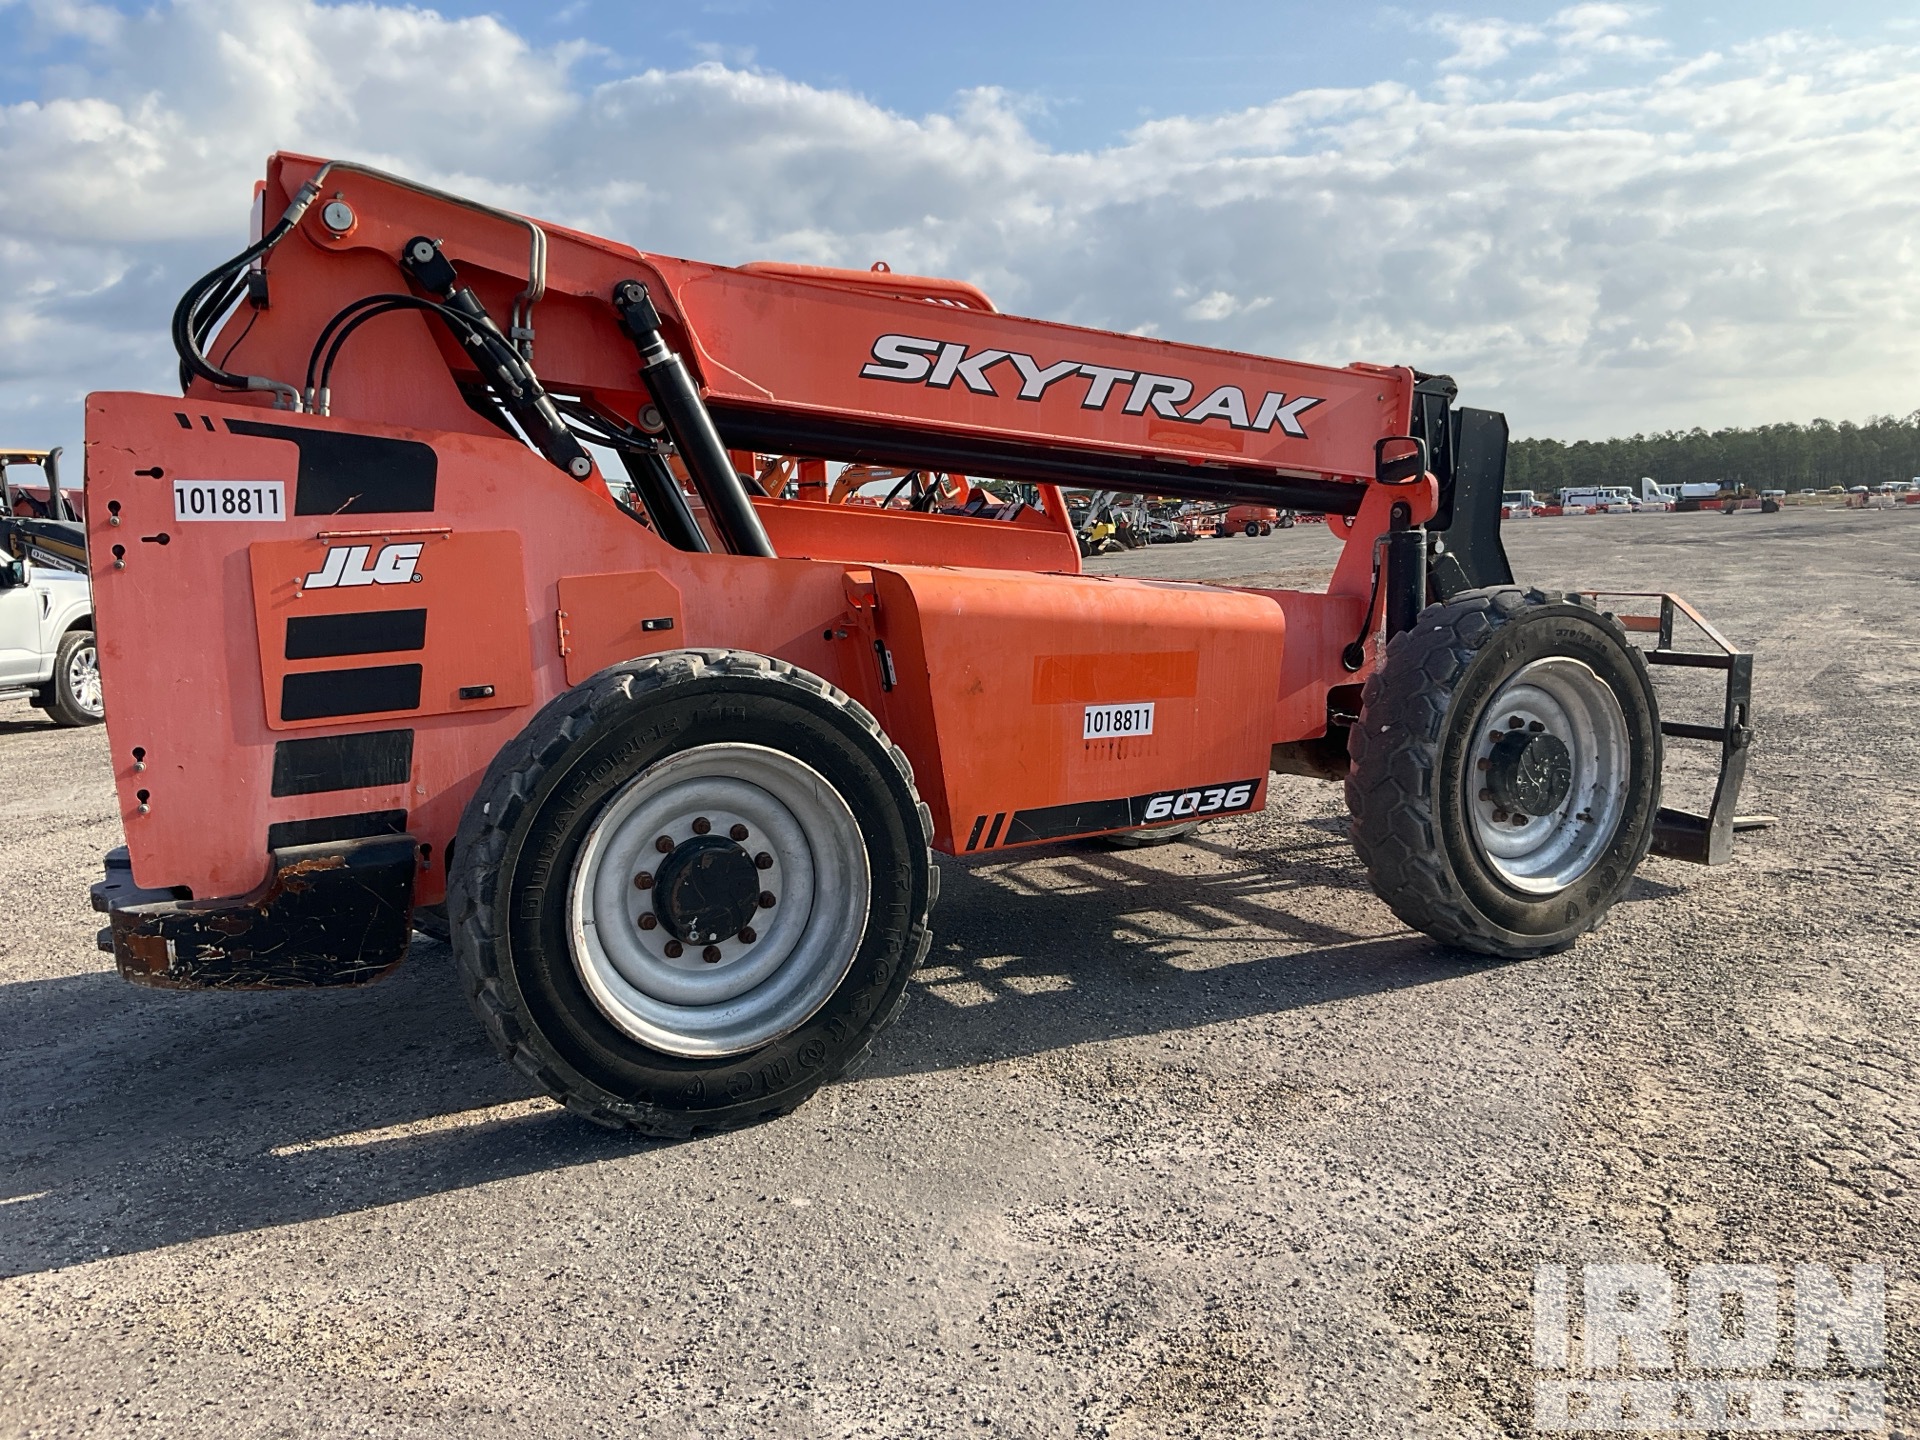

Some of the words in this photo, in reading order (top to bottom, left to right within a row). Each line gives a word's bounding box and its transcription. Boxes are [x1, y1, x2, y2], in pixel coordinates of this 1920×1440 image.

[859, 334, 1326, 438] SKYTRAK
[175, 488, 280, 514] 1018811
[304, 542, 424, 590] JLG
[1085, 709, 1150, 733] 1018811
[1144, 784, 1252, 819] 6036
